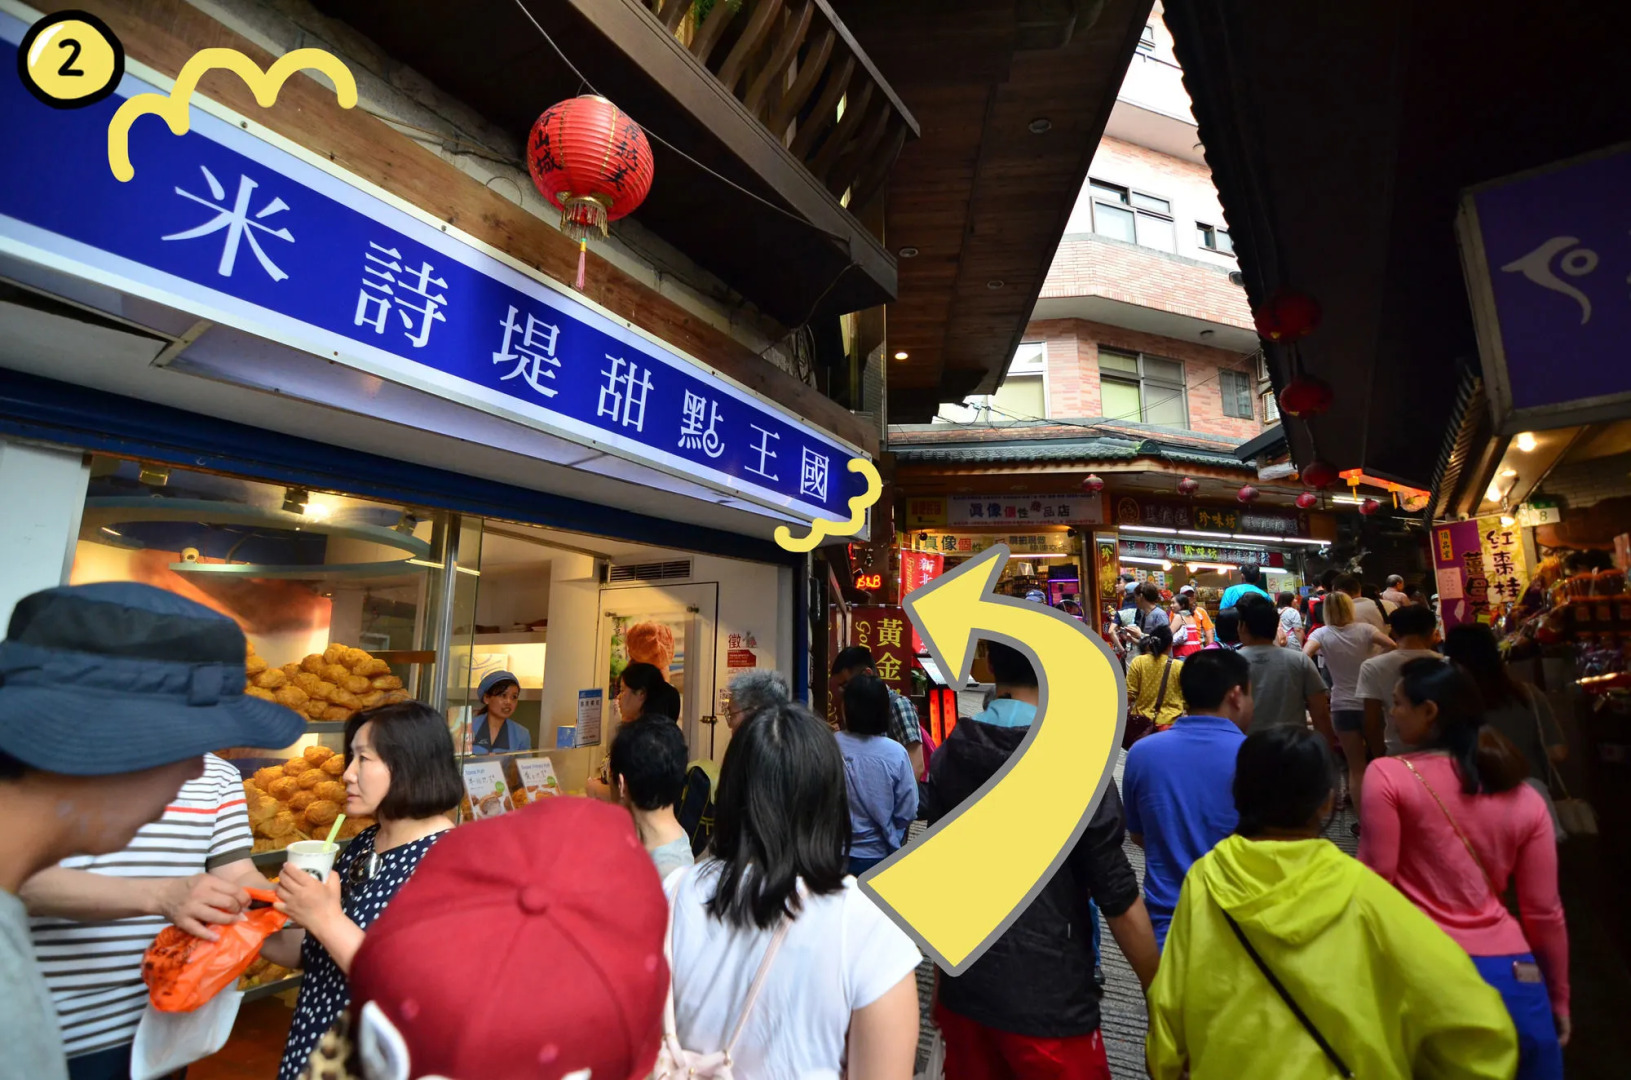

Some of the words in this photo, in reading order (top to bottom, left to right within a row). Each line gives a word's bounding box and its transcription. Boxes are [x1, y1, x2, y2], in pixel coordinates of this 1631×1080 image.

[160, 163, 830, 503] 米詩堤甜點王國
[1539, 510, 1548, 522] 8
[1486, 530, 1521, 604] 紅棗桂
[875, 617, 904, 695] 黃金
